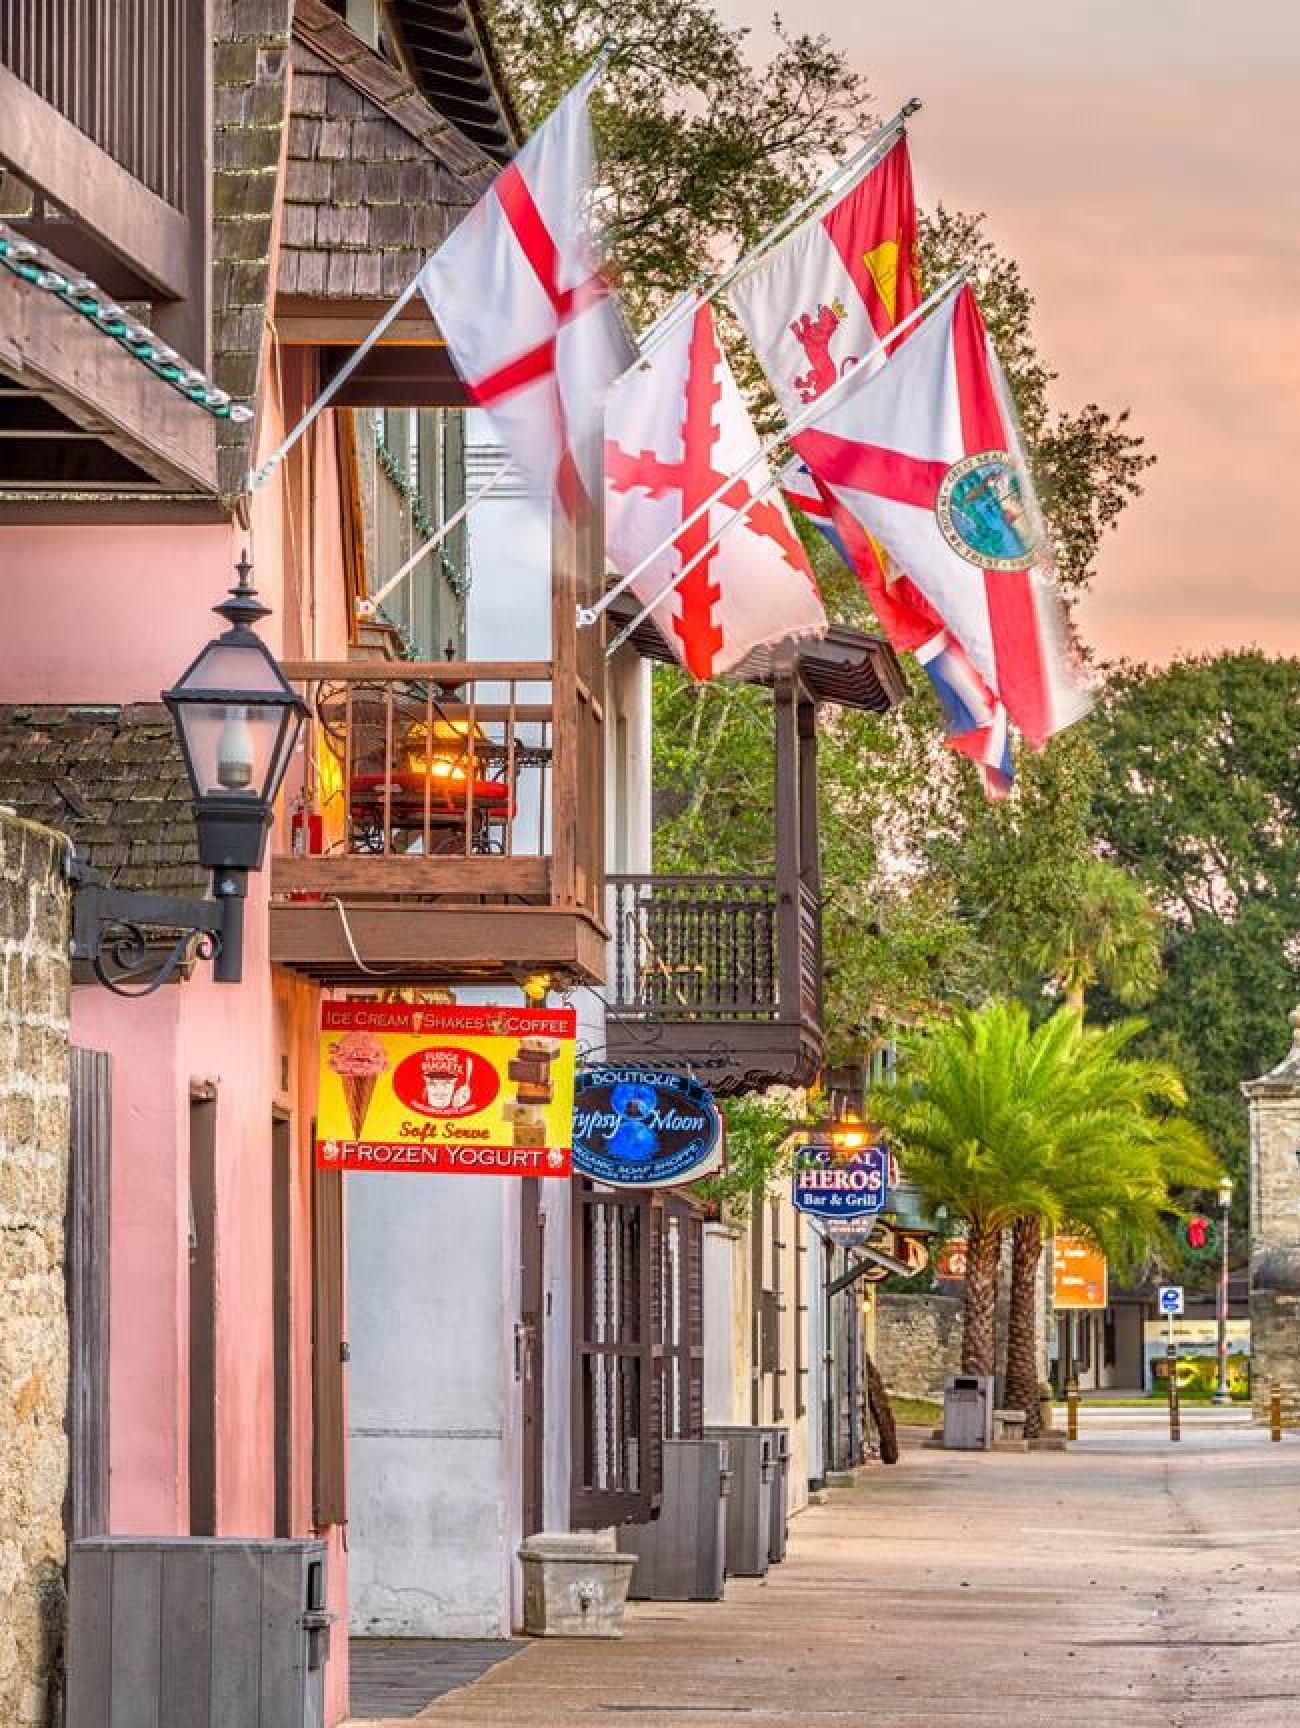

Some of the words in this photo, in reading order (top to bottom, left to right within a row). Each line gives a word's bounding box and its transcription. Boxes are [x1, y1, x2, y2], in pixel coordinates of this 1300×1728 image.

[326, 1009, 352, 1025] ICE
[355, 1010, 409, 1029] CREAM
[423, 1013, 485, 1030] SHAKES
[507, 1016, 568, 1033] COFFEE
[591, 1071, 680, 1087] BOUTIQUE
[399, 1121, 439, 1142] Soft
[441, 1121, 490, 1140] Serve
[572, 1107, 621, 1139] ypsy
[650, 1107, 704, 1131] Moon
[342, 1142, 439, 1164] FROZEN
[444, 1144, 544, 1168] YOGURT
[799, 1169, 881, 1191] HEROS
[803, 1193, 827, 1205] Bar
[829, 1193, 843, 1206] &
[845, 1193, 877, 1206] Grill
